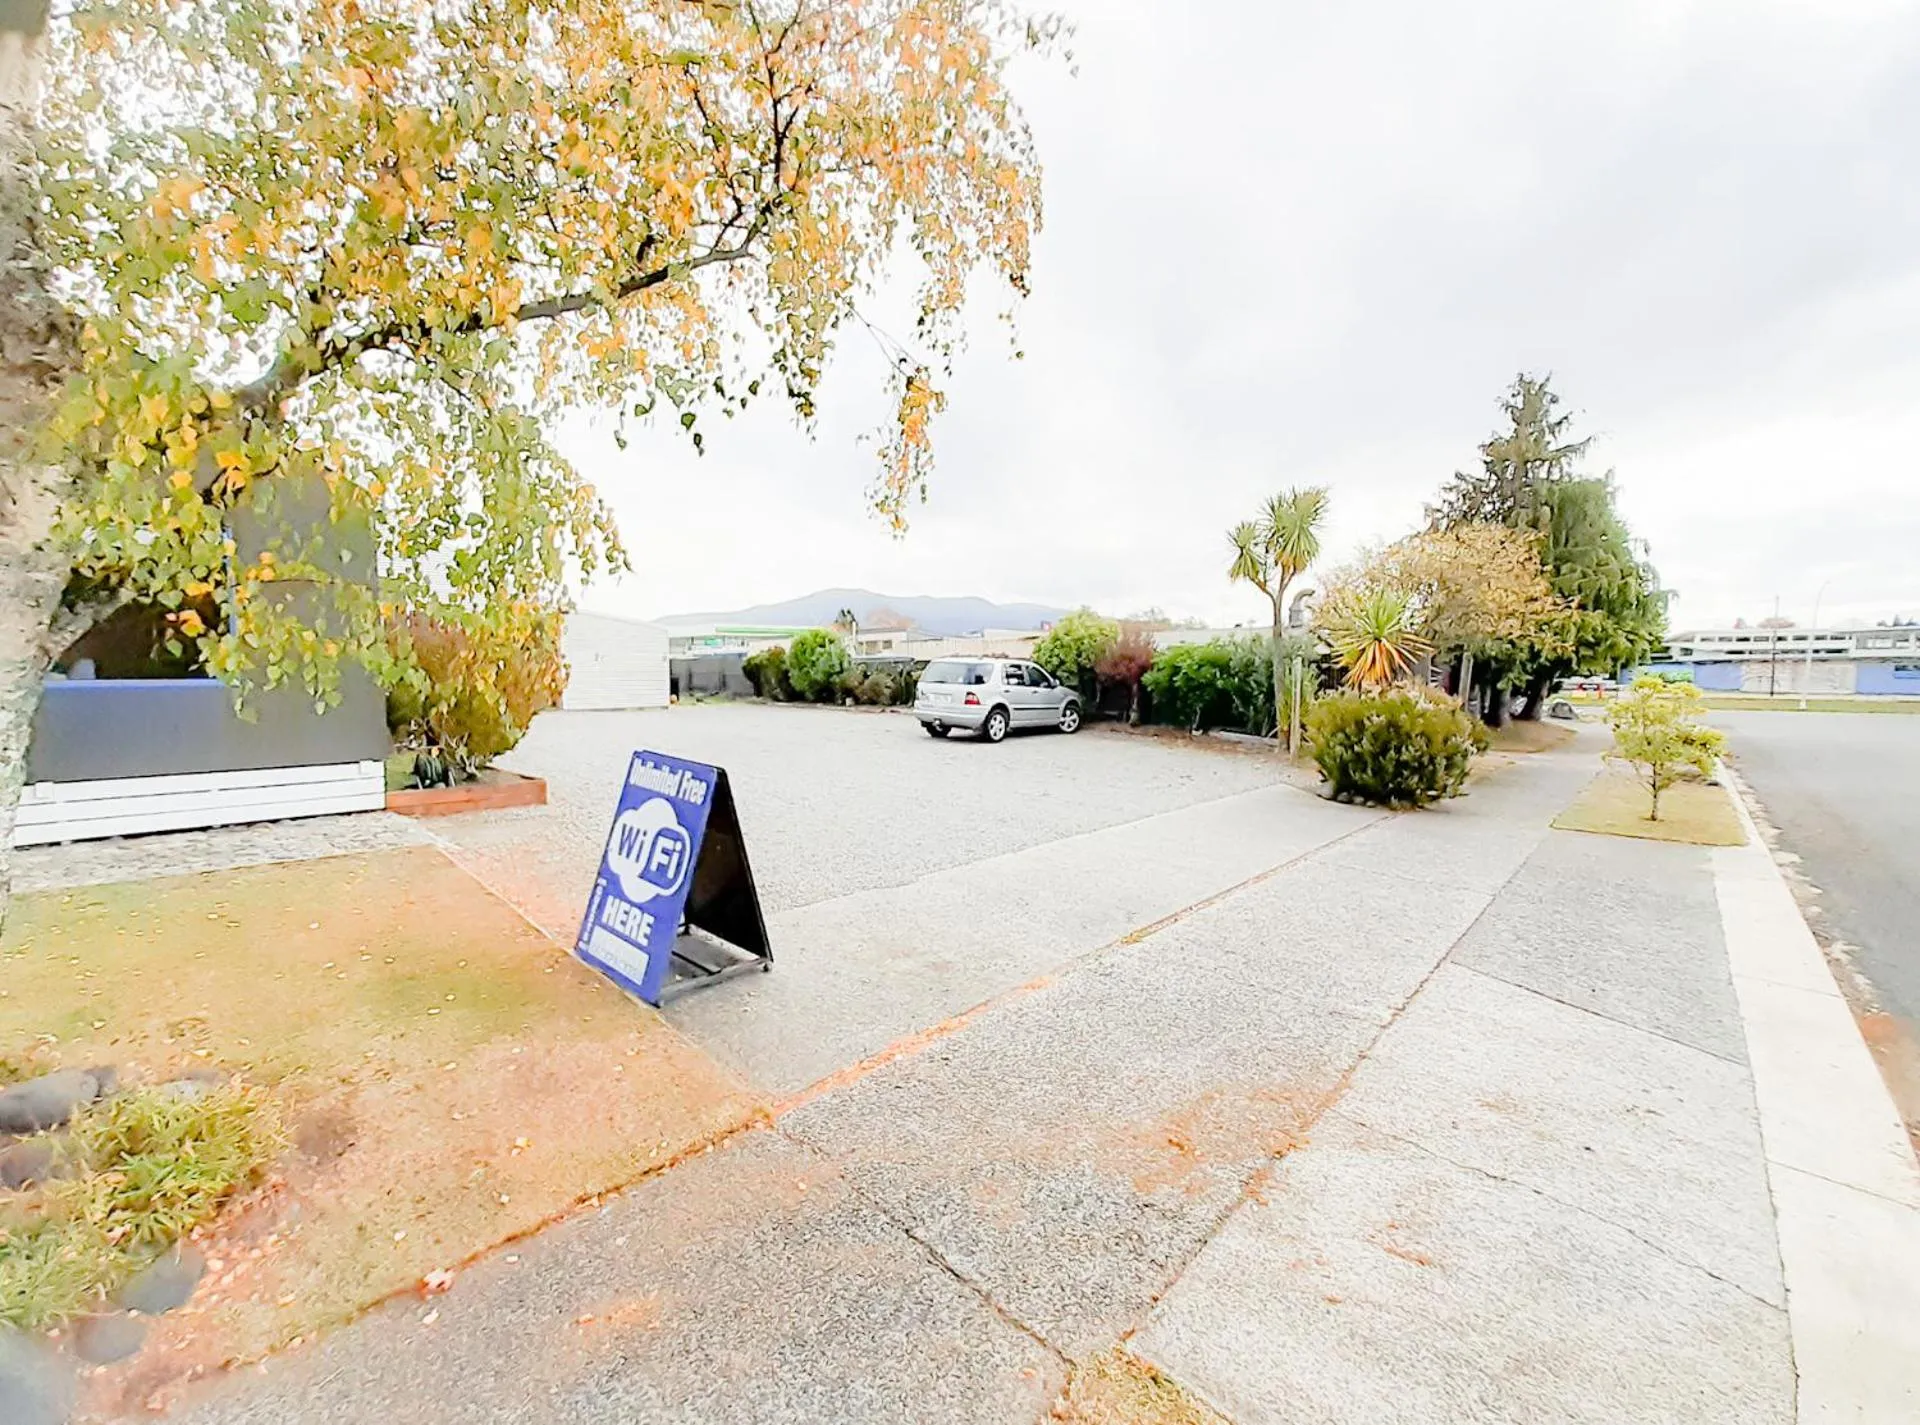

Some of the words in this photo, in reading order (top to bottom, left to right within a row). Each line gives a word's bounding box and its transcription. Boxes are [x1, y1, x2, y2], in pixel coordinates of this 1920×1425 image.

[629, 757, 682, 797] Unlimited
[679, 769, 708, 806] Free
[601, 895, 655, 947] HERE
